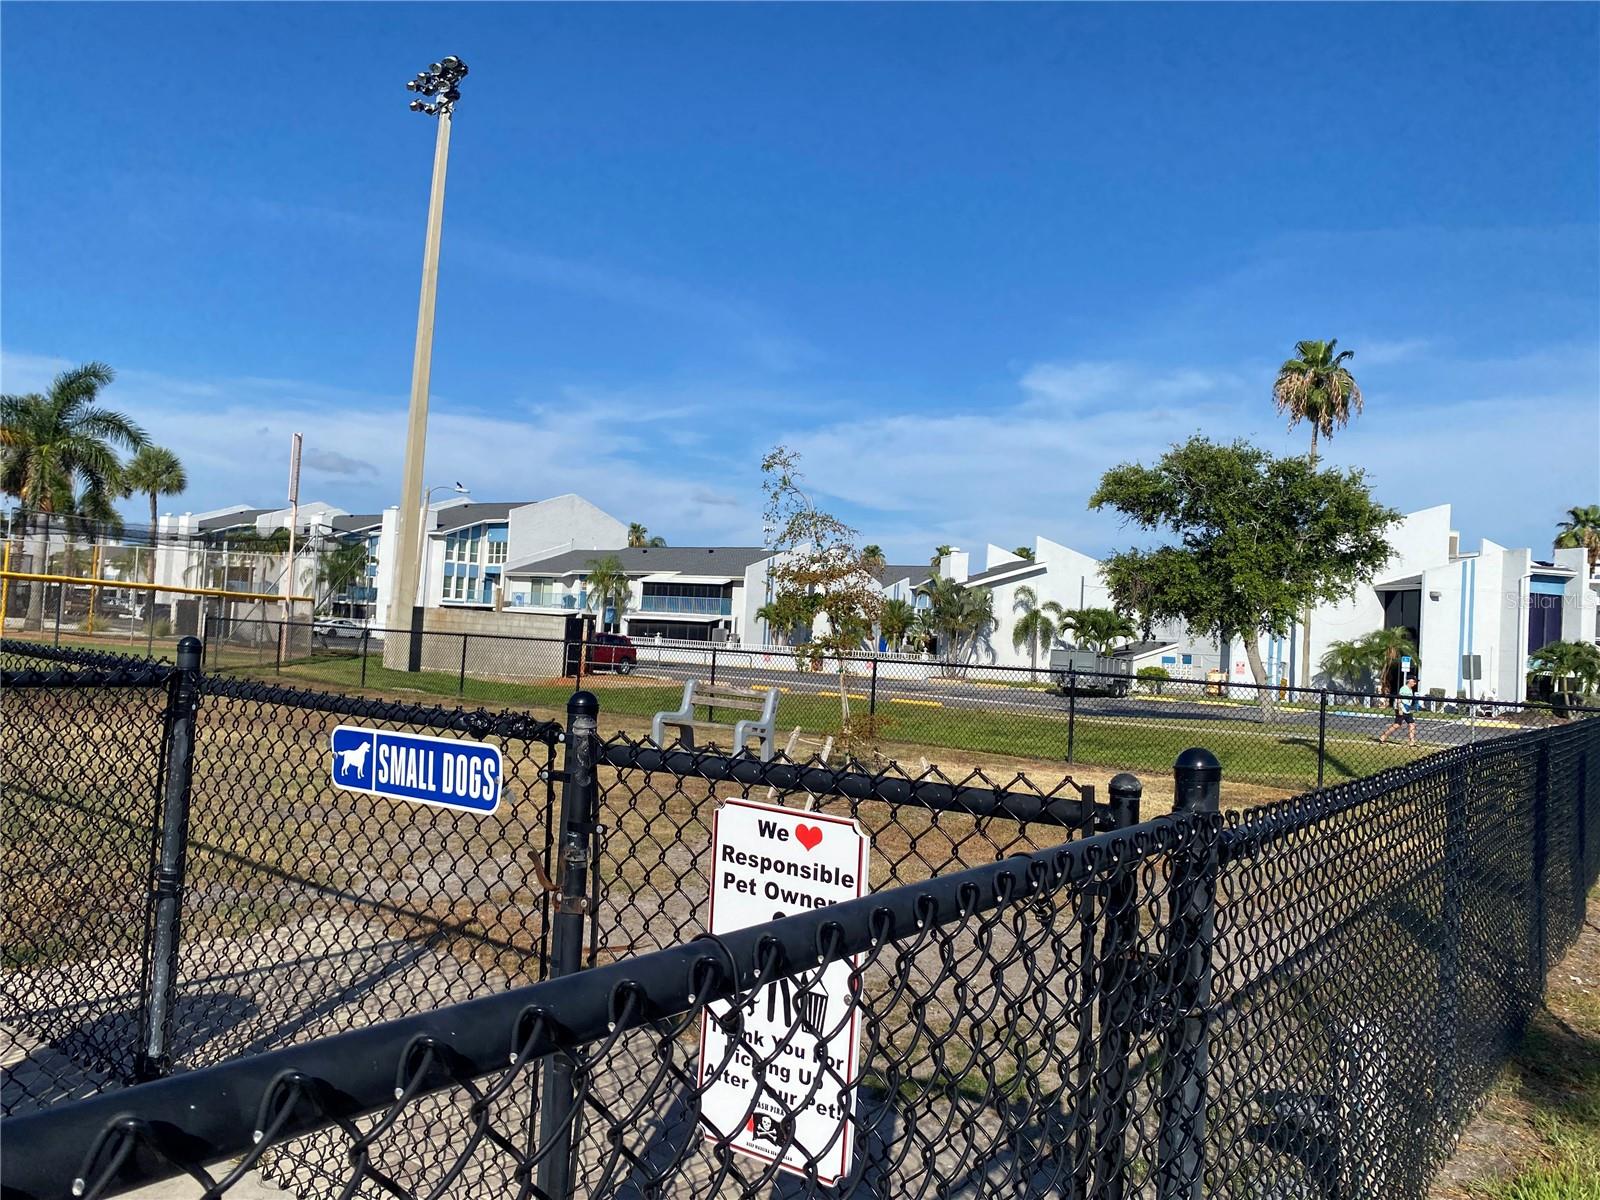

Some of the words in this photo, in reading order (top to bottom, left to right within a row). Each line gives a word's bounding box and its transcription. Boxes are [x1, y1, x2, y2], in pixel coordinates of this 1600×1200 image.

[378, 743, 437, 792] SMALL
[441, 752, 496, 801] DOGS
[757, 819, 790, 842] We
[721, 844, 855, 888] Responsible
[723, 872, 757, 896] Pet
[764, 881, 838, 909] Owner
[710, 1016, 764, 1047] Tnk
[704, 1063, 749, 1090] Ater
[724, 1044, 791, 1083] icng
